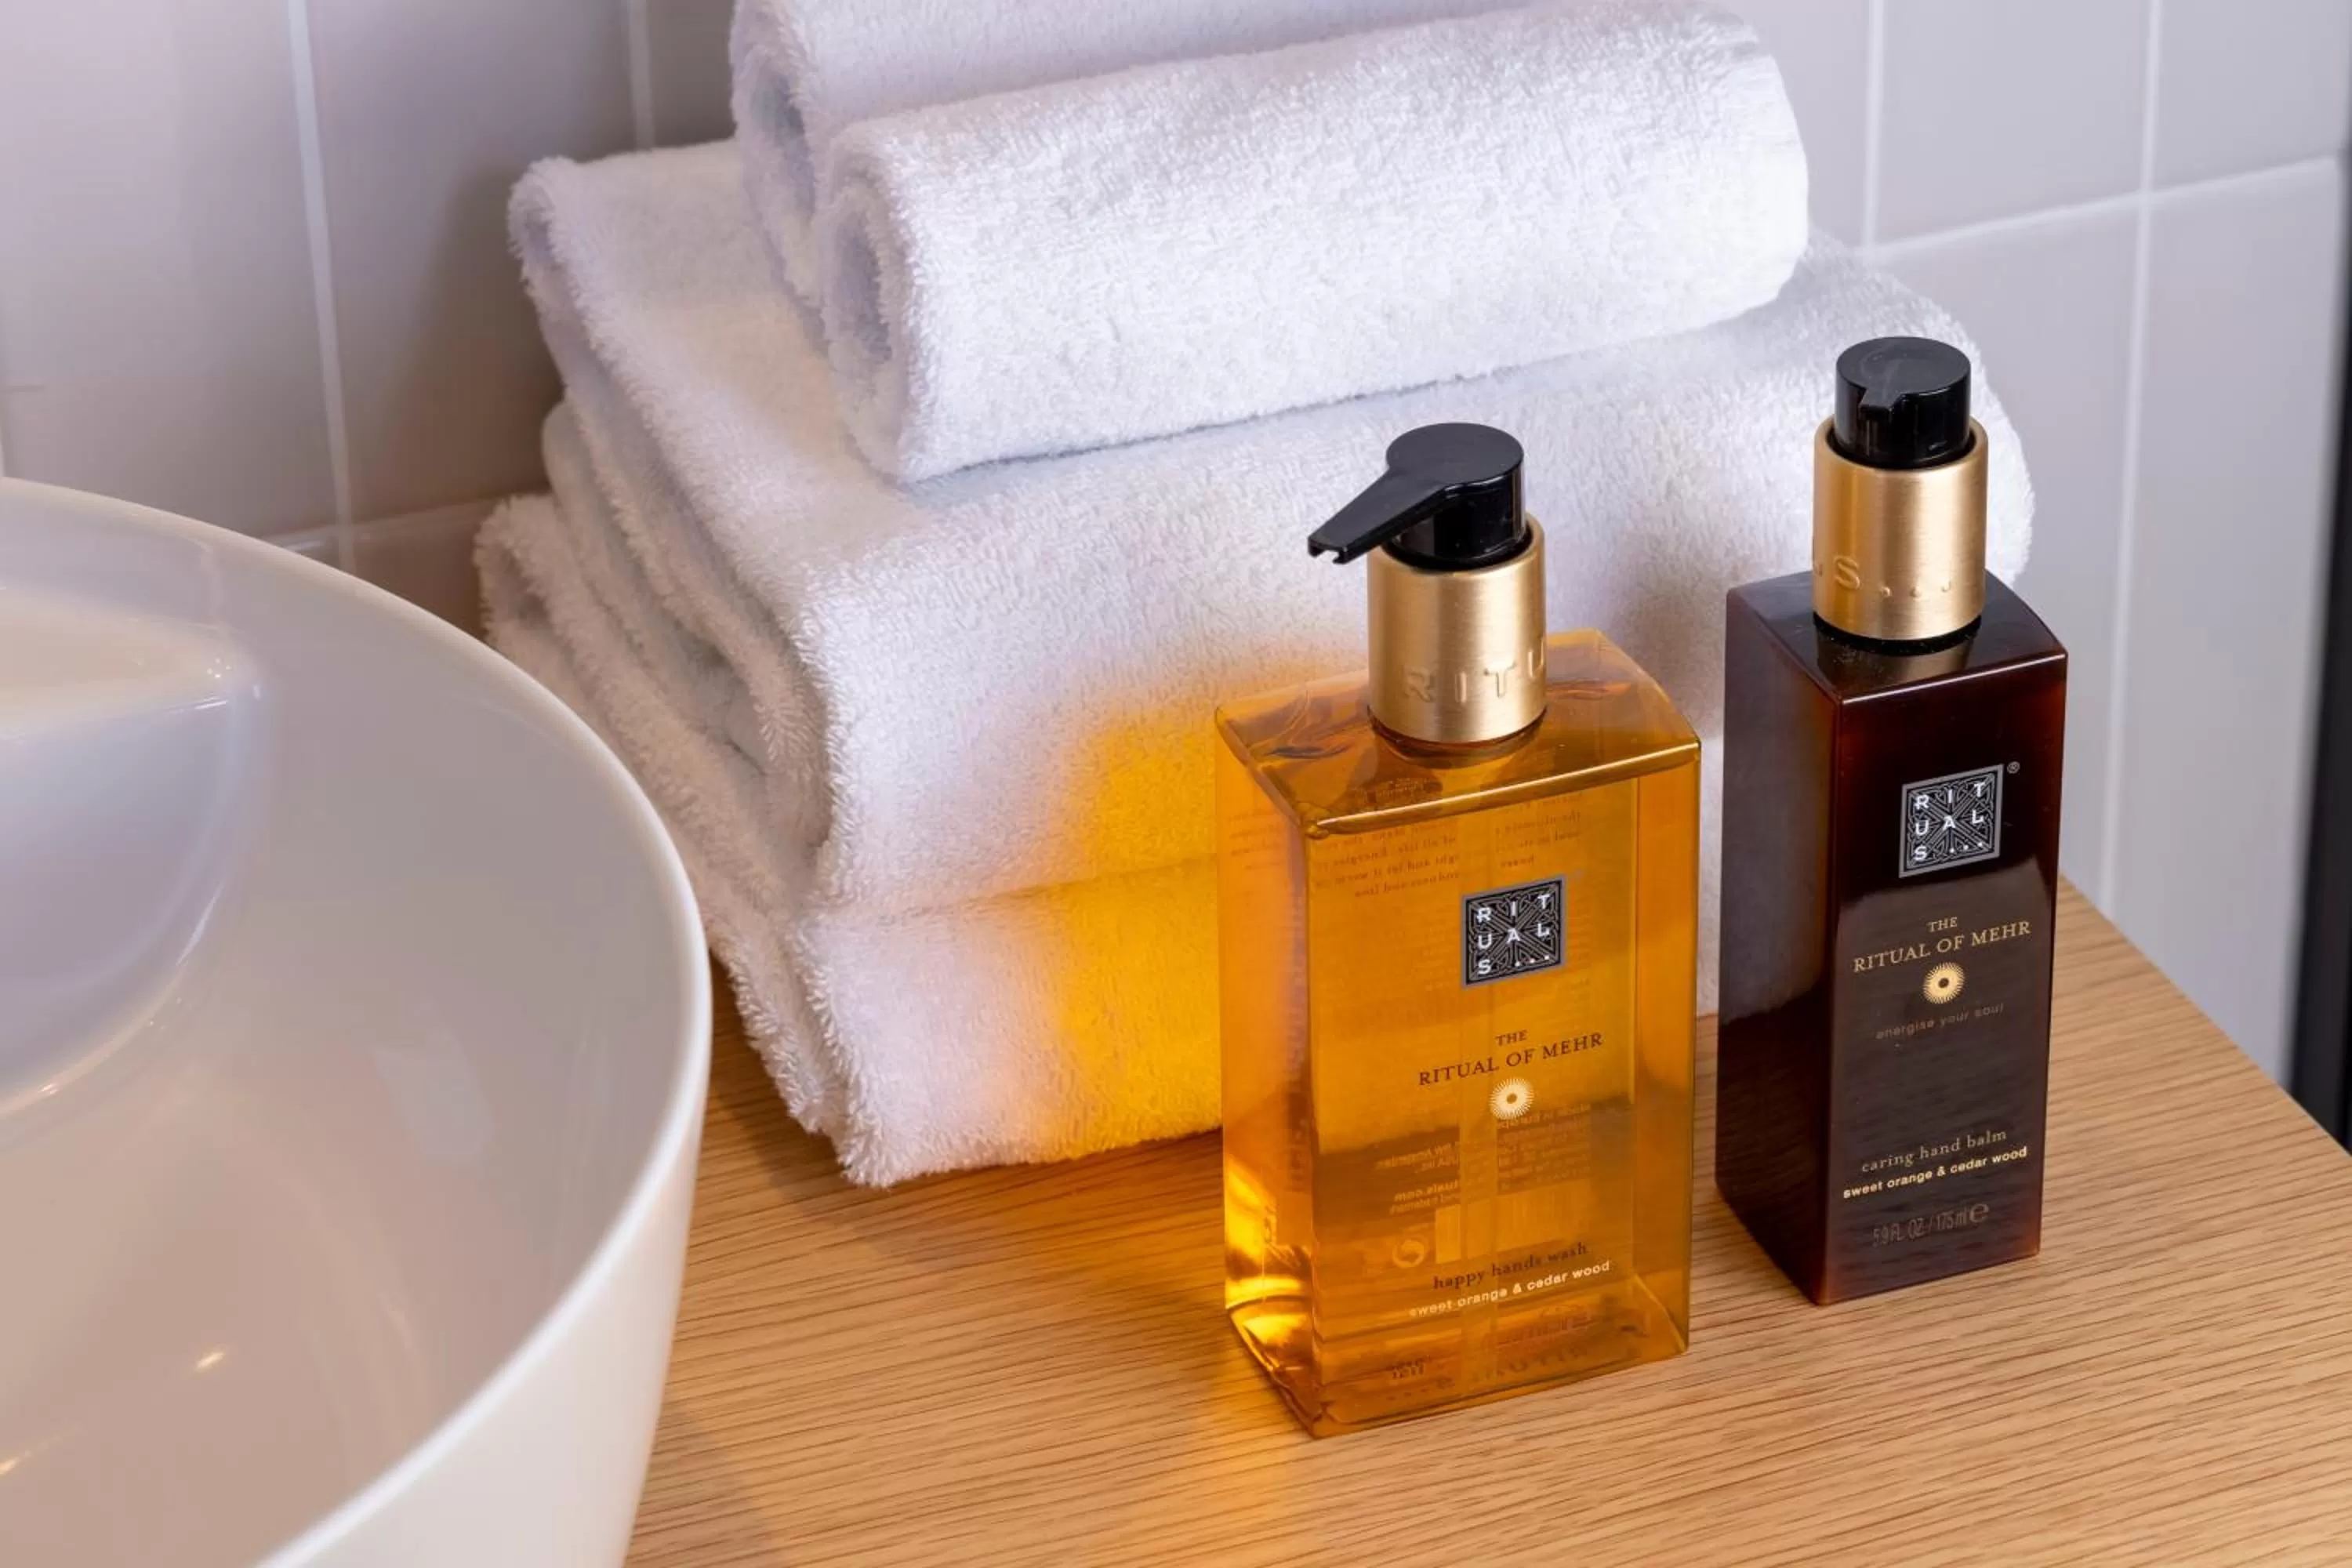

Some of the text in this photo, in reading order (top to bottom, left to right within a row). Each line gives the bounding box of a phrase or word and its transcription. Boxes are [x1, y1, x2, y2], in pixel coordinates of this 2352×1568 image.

[1853, 920, 2032, 973] RITUAL OF MEHR
[1927, 916, 1958, 933] THE
[1495, 1029, 1528, 1047] THE
[1940, 1011, 1969, 1028] your
[1974, 1003, 2004, 1018] soul
[1419, 1032, 1602, 1086] RITUAL OF MEHR
[1843, 1145, 2029, 1199] sweet orange & cedar wood
[1862, 1130, 2007, 1173] caring hand balm
[1409, 1260, 1611, 1318] sweet orange & cedar wood
[1433, 1241, 1588, 1290] happy hands wash
